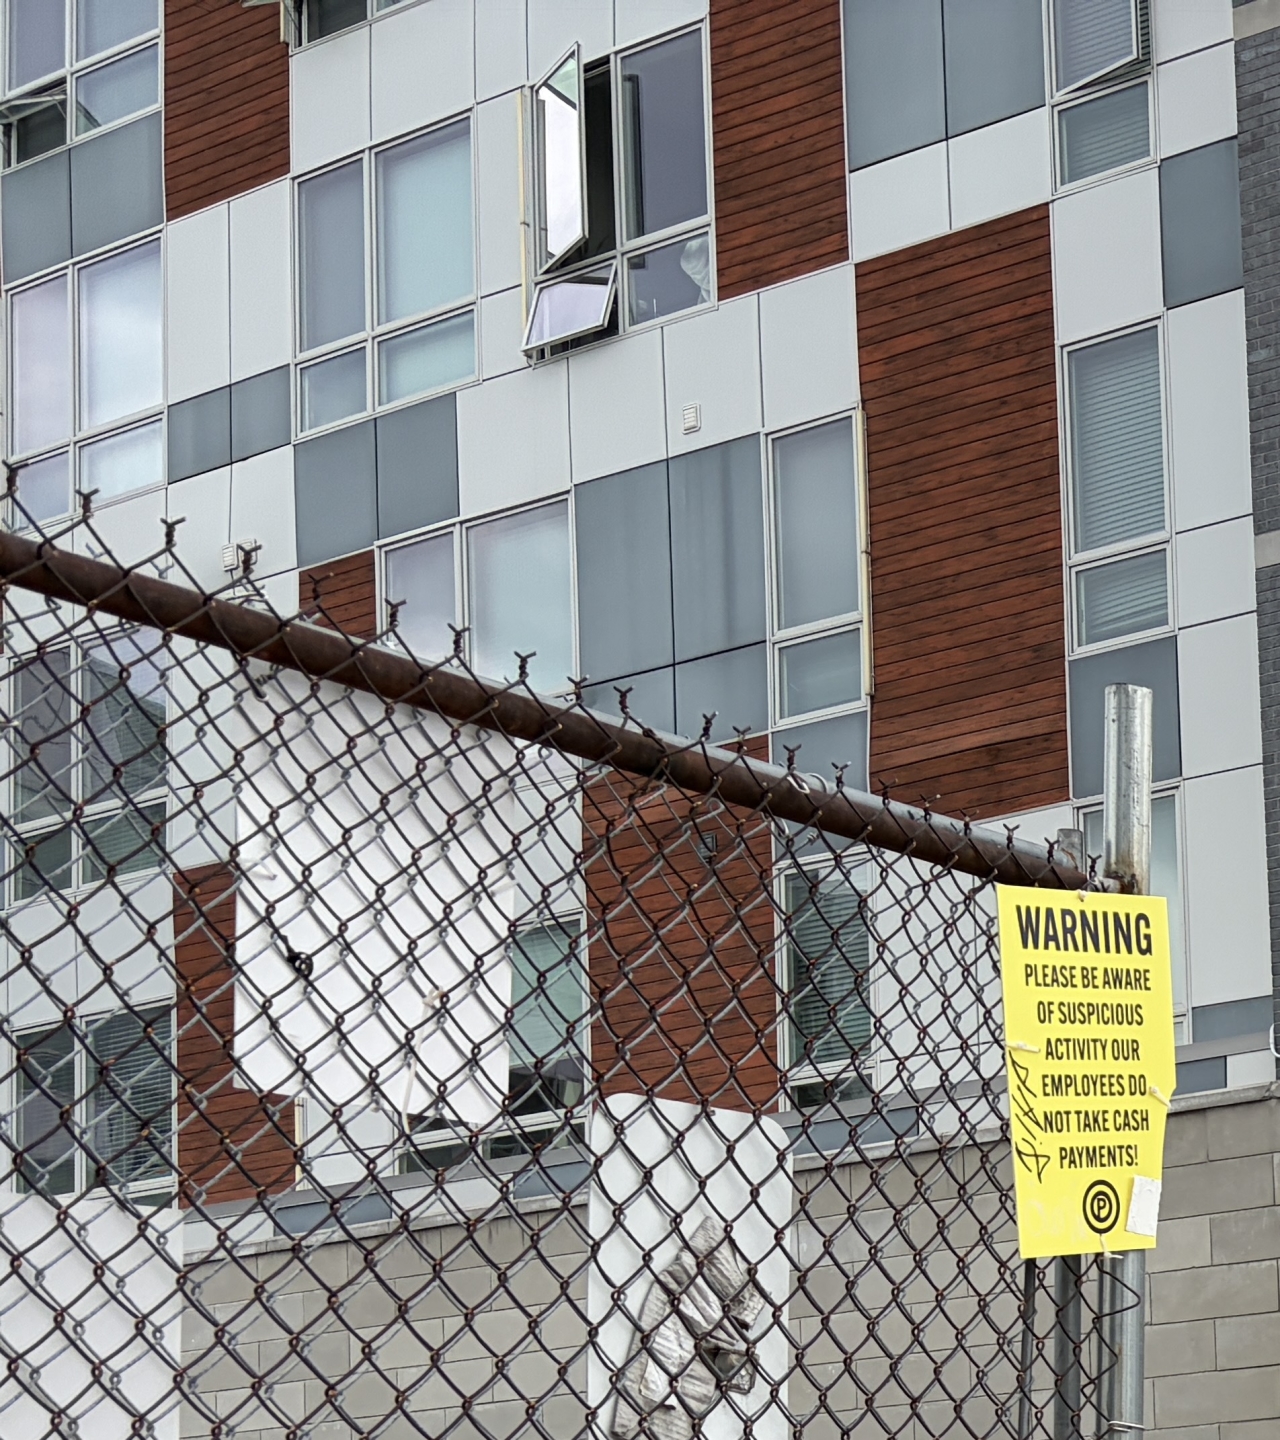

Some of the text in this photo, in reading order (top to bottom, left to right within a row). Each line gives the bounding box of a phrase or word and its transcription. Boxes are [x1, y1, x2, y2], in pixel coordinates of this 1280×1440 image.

[1015, 905, 1152, 956] WARNING
[1024, 964, 1151, 991] PLEASE BE AWARE
[1037, 1001, 1143, 1026] OF SUSPICIOUS
[1045, 1037, 1140, 1061] ACTIVITY OUR
[1042, 1074, 1147, 1097] EMPLOYEES DO
[1043, 1109, 1149, 1133] NOT TAKE CASH
[1059, 1144, 1138, 1169] PAYMENTS!
